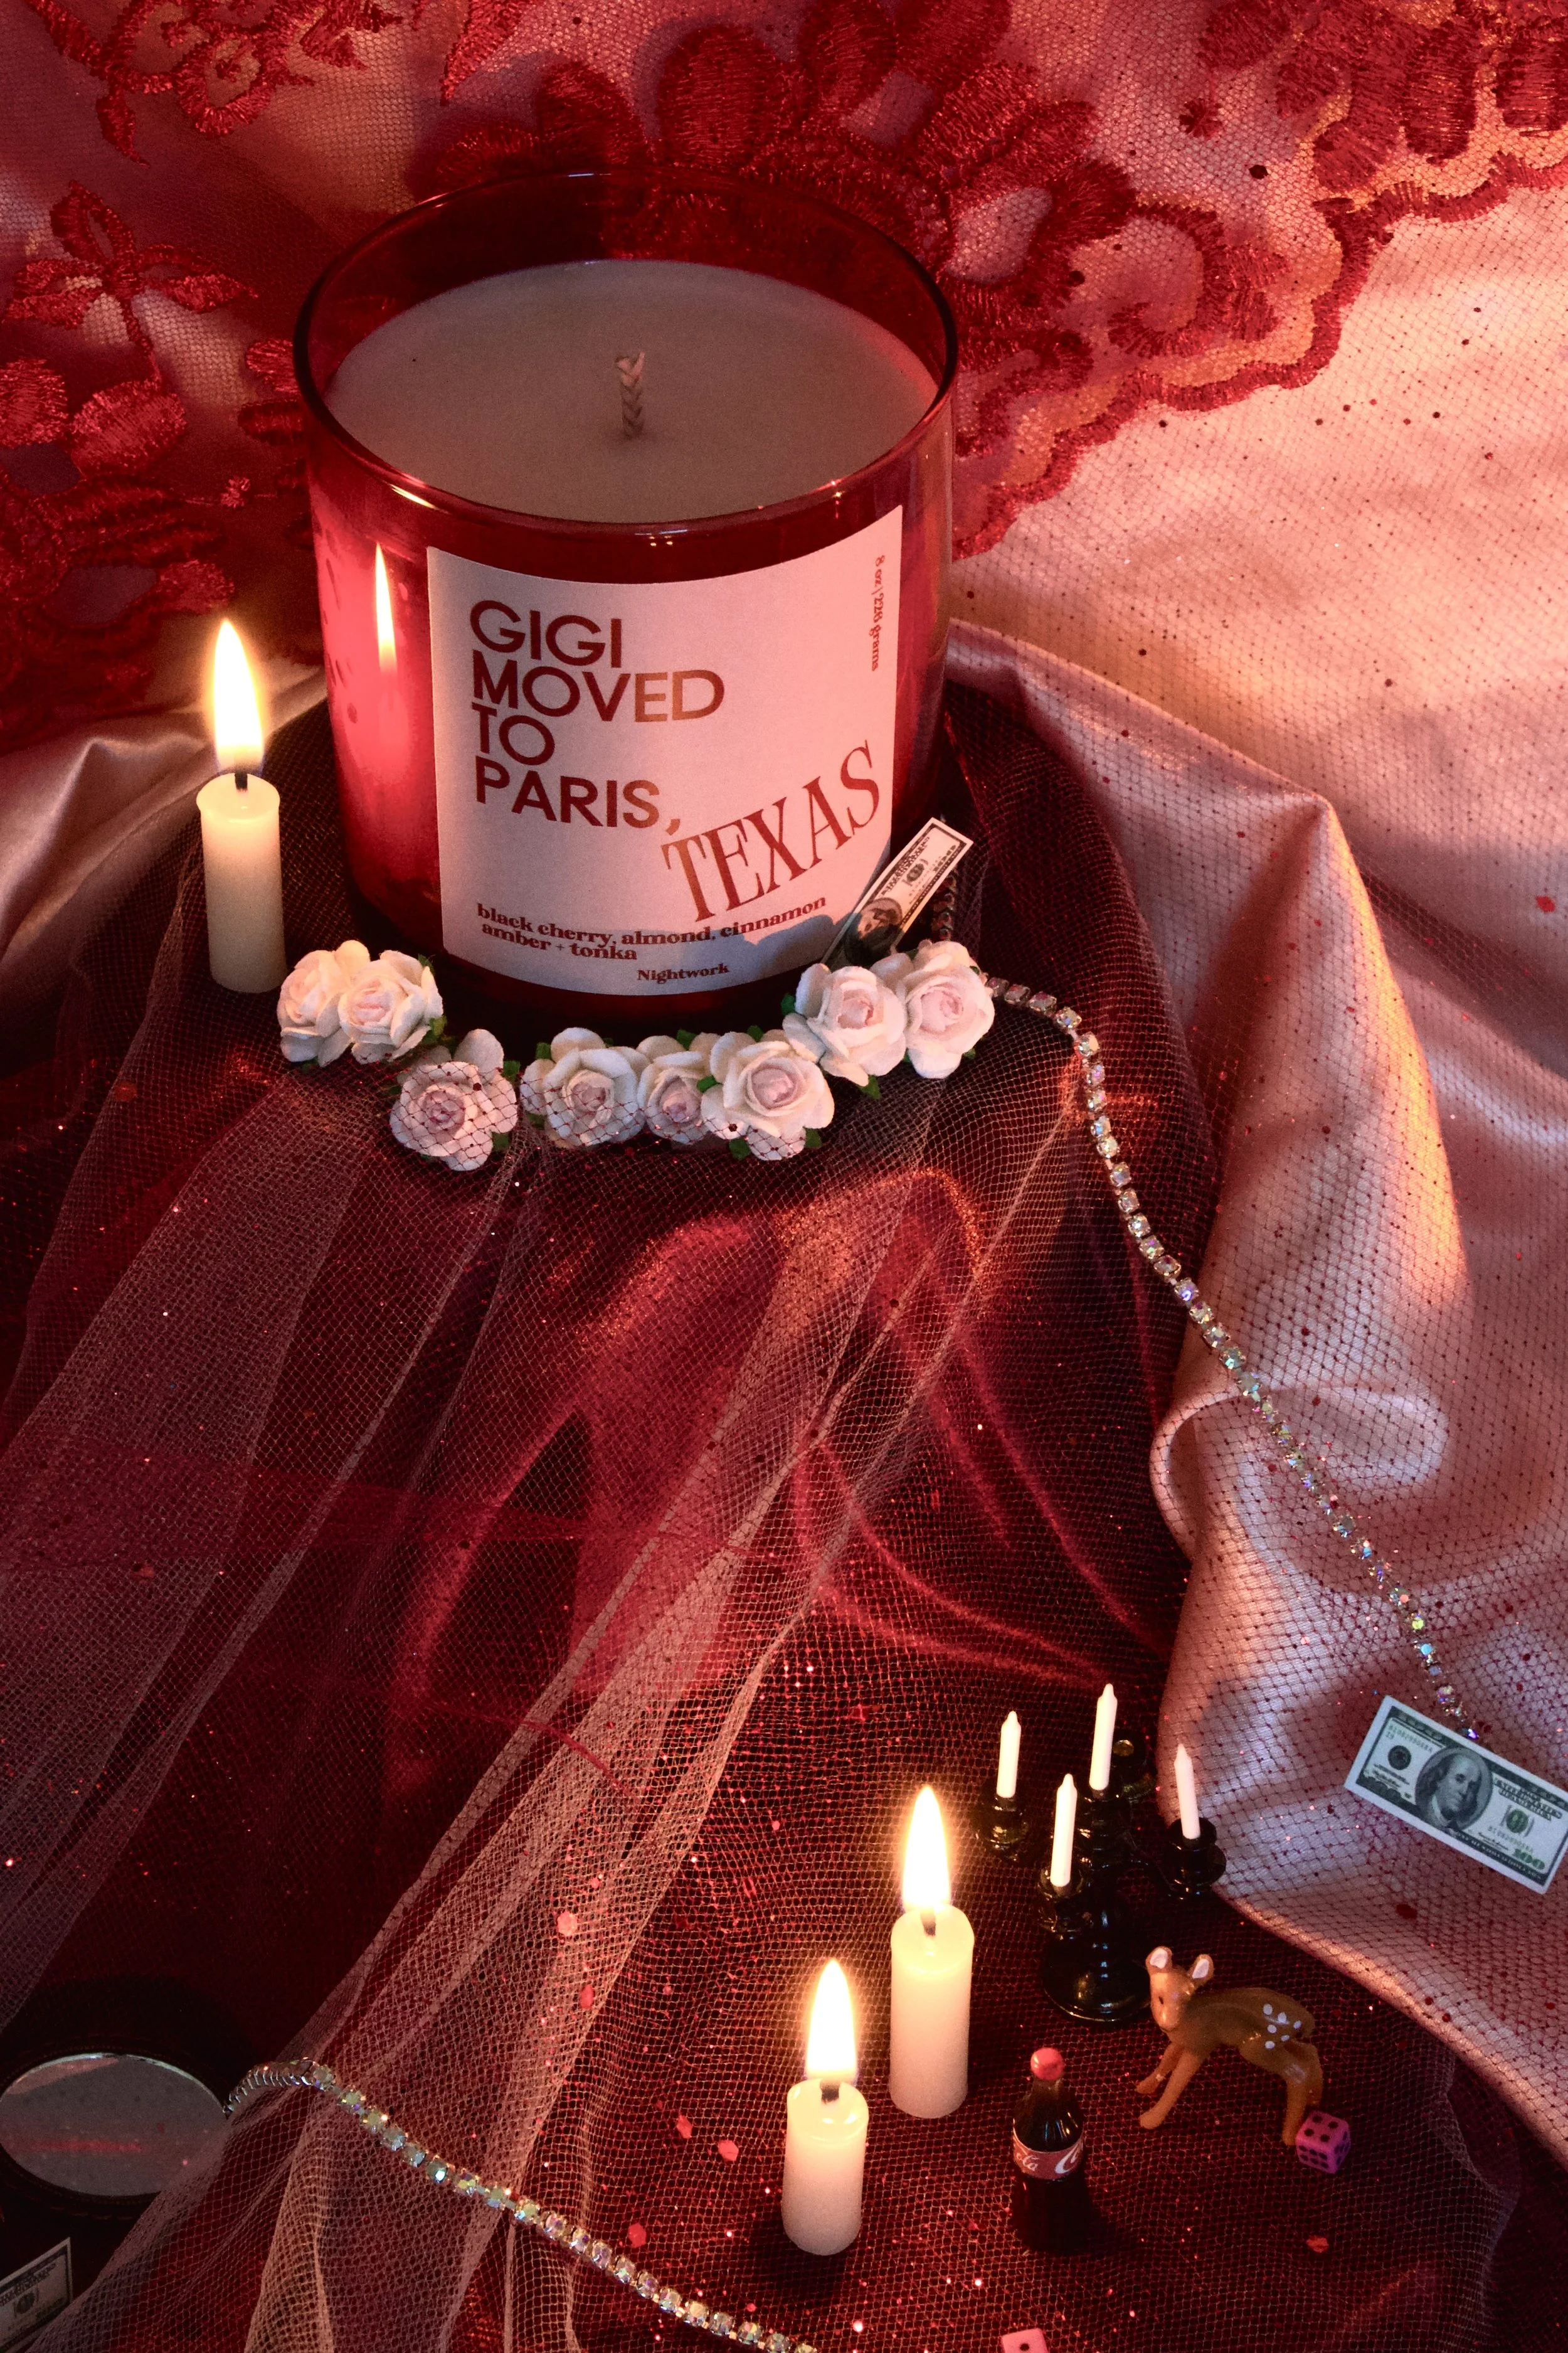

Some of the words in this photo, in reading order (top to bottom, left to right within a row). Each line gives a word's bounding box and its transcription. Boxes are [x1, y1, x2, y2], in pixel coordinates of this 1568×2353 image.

[874, 568, 882, 588] oz
[876, 555, 886, 567] 8
[470, 600, 623, 668] GIGI
[869, 624, 882, 671] grams
[472, 651, 725, 723] MOVED
[471, 704, 556, 767] TO
[475, 758, 681, 836] PARIS,
[661, 740, 880, 922] TEXAS
[477, 903, 534, 933] black
[721, 898, 826, 938] cinnamon
[482, 923, 552, 951] amber
[569, 943, 638, 960] tonka
[637, 963, 730, 985] Nightwork
